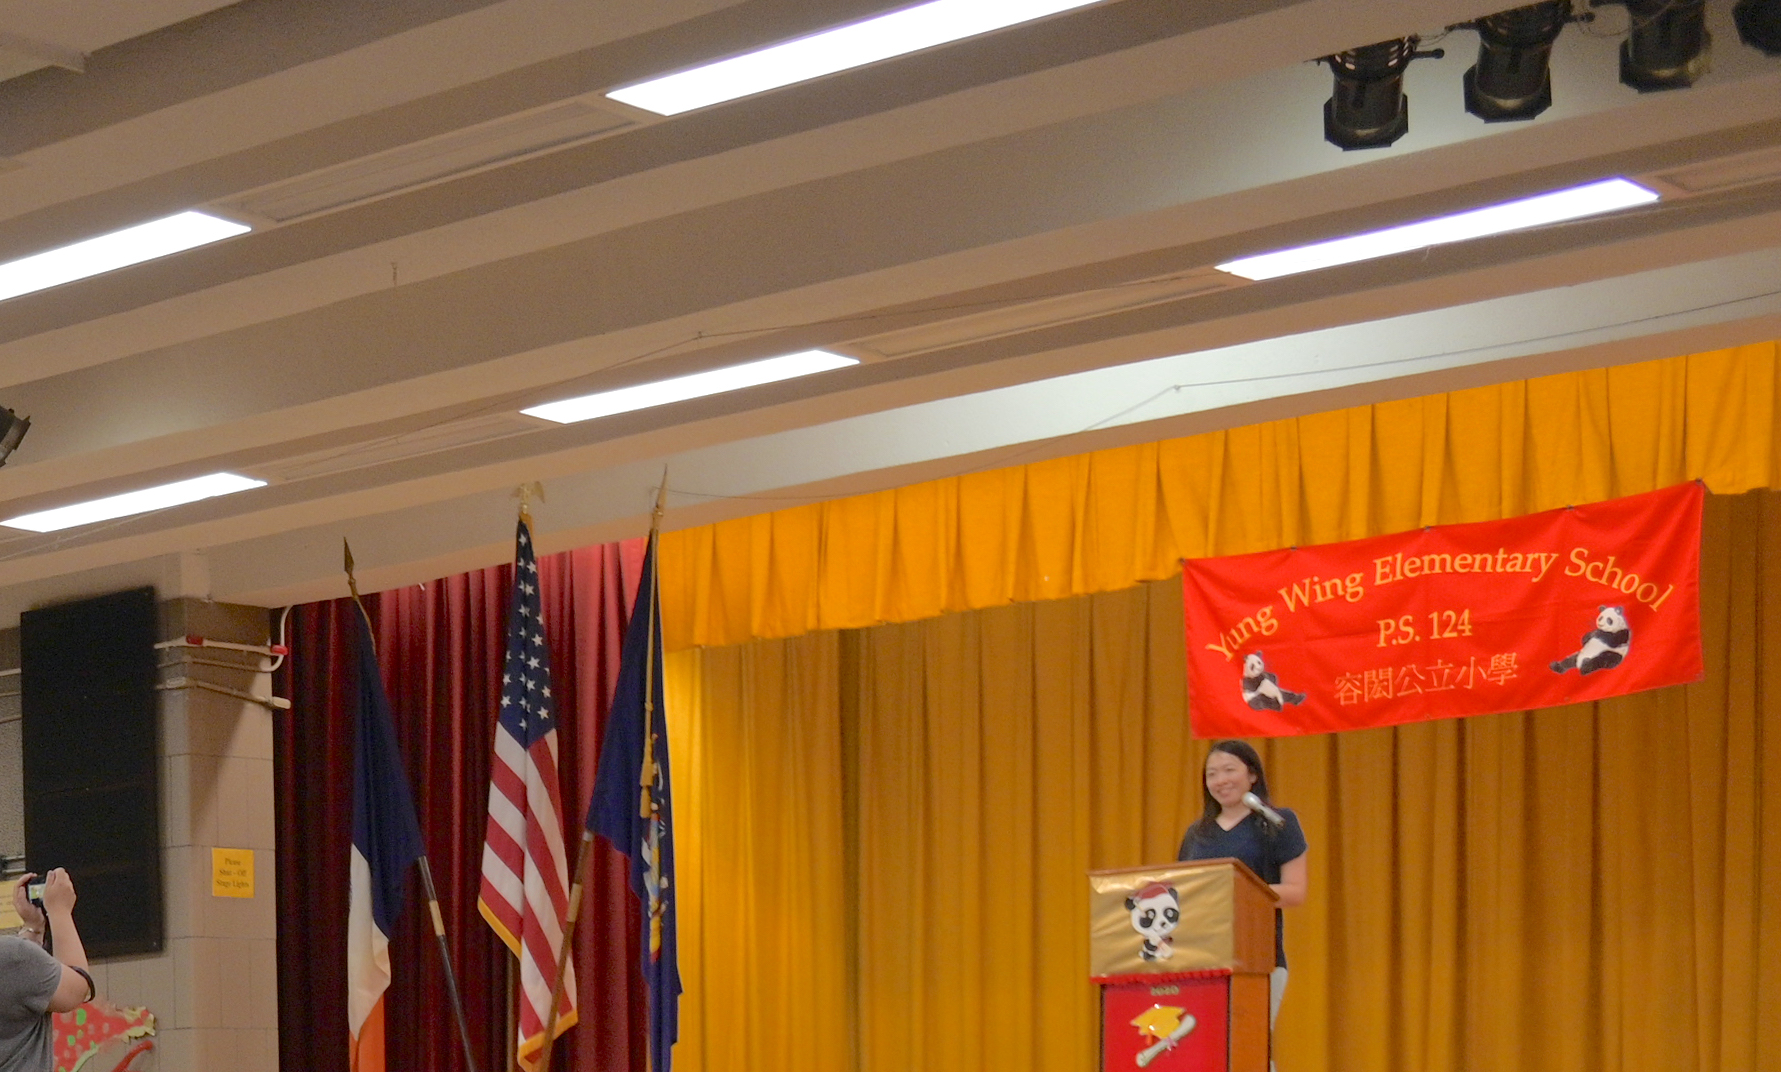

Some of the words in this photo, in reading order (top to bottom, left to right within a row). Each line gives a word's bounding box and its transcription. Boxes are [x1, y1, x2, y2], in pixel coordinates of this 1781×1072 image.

[1205, 605, 1279, 662] Yung
[1277, 572, 1364, 613] Wing
[1372, 547, 1559, 586] Elementary
[1564, 547, 1674, 612] School
[1376, 615, 1420, 648] P.S.
[1428, 608, 1473, 640] 124
